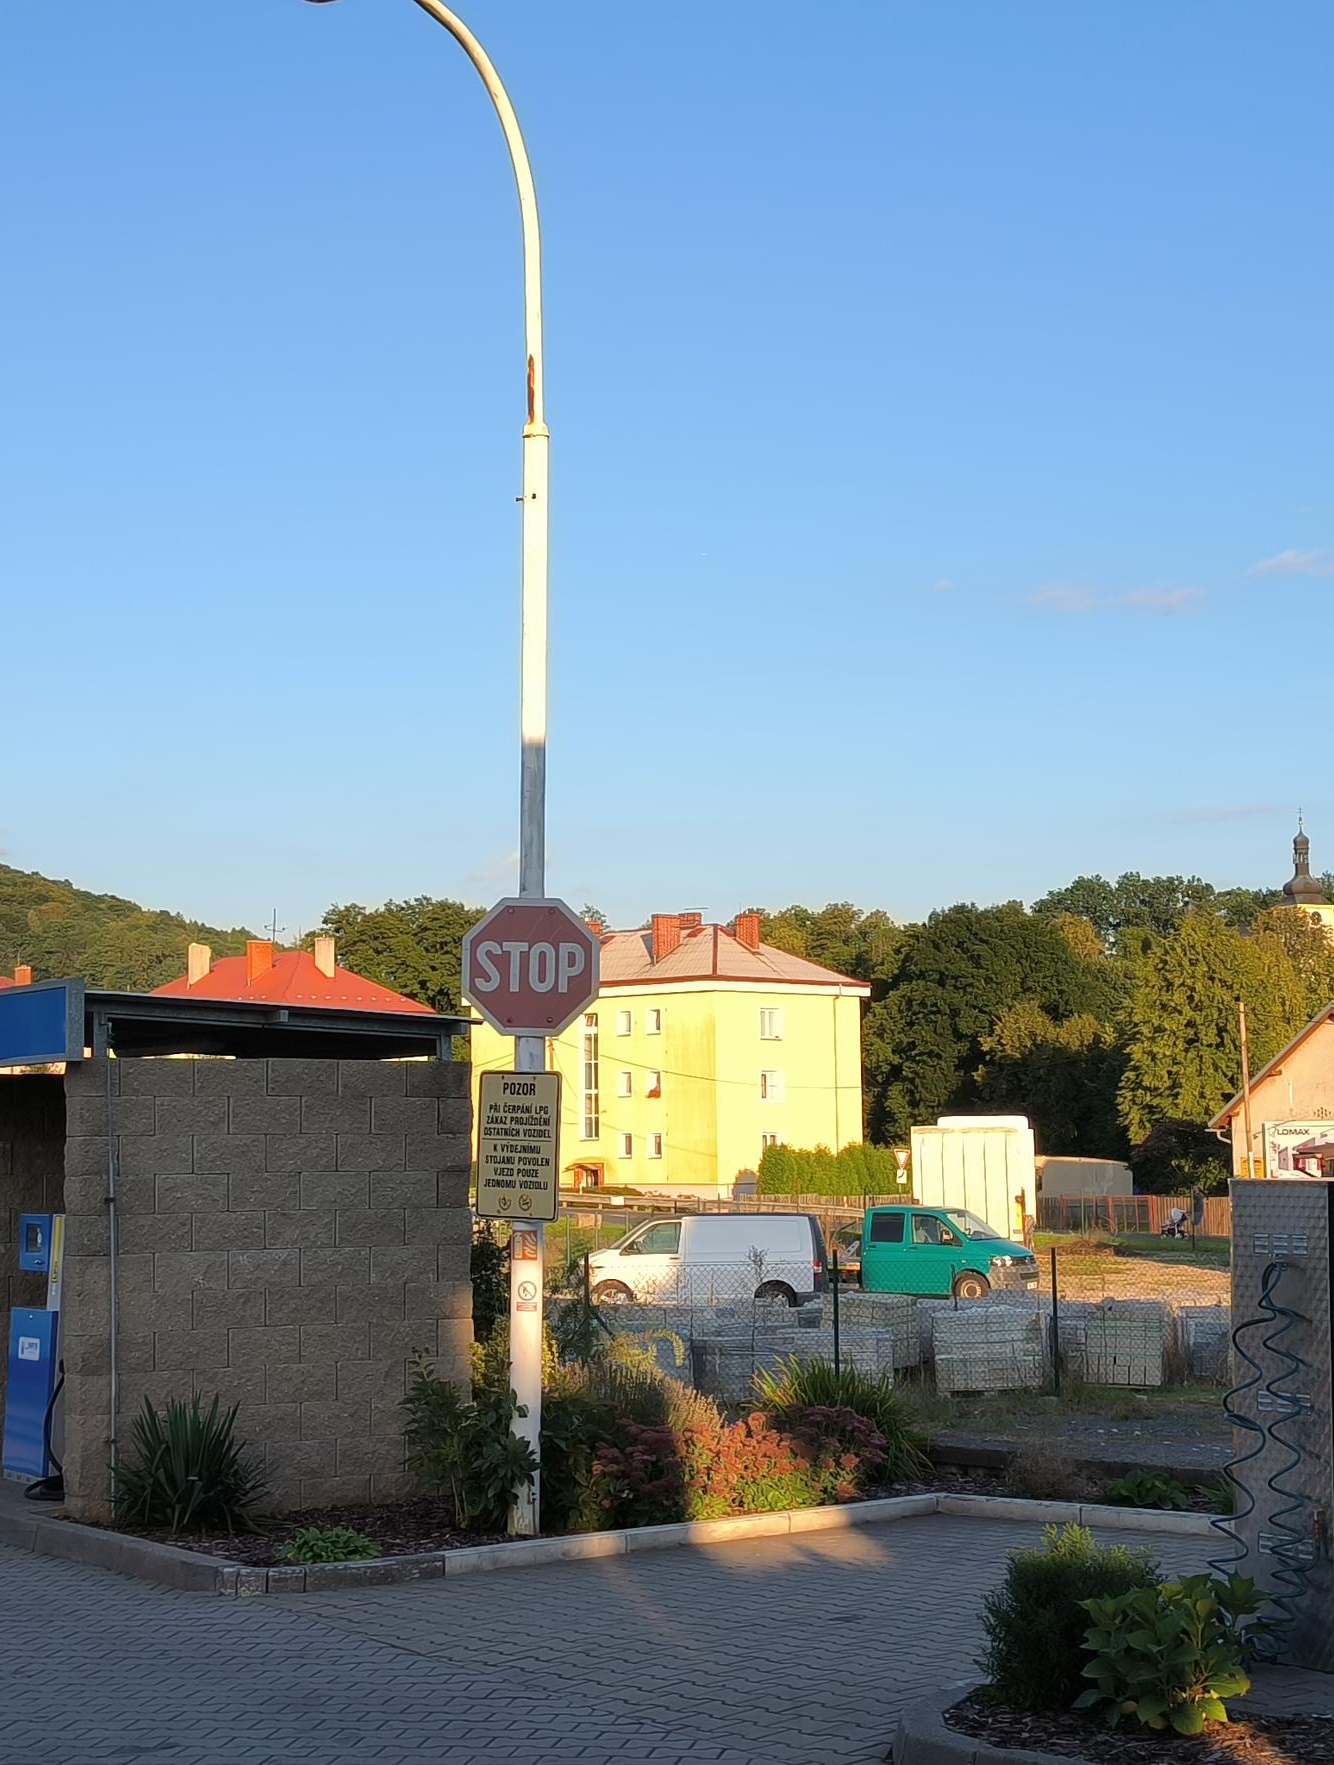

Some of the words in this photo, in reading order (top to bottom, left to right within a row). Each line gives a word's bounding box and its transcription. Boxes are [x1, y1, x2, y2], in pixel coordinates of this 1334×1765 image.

[474, 940, 585, 993] STOP
[502, 1082, 536, 1096] POZOR
[489, 1102, 501, 1113] PŘI
[503, 1102, 533, 1115] ČERPÁNÍ
[535, 1105, 549, 1115] LPG
[486, 1115, 508, 1125] ZÁKAZ
[484, 1126, 520, 1137] OSTATNÍCH
[523, 1128, 551, 1138] VOZIDEL
[1277, 1128, 1310, 1136] LOMAX
[493, 1144, 499, 1152] K
[500, 1142, 541, 1154] VÝDEJNÍMU
[485, 1155, 516, 1165] STOJANU
[518, 1156, 550, 1166] POVOLEN
[494, 1167, 515, 1177] VJEZD
[517, 1168, 539, 1178] POUZE
[484, 1179, 517, 1189] JEDNOMU
[519, 1180, 548, 1190] VOZIDLU
